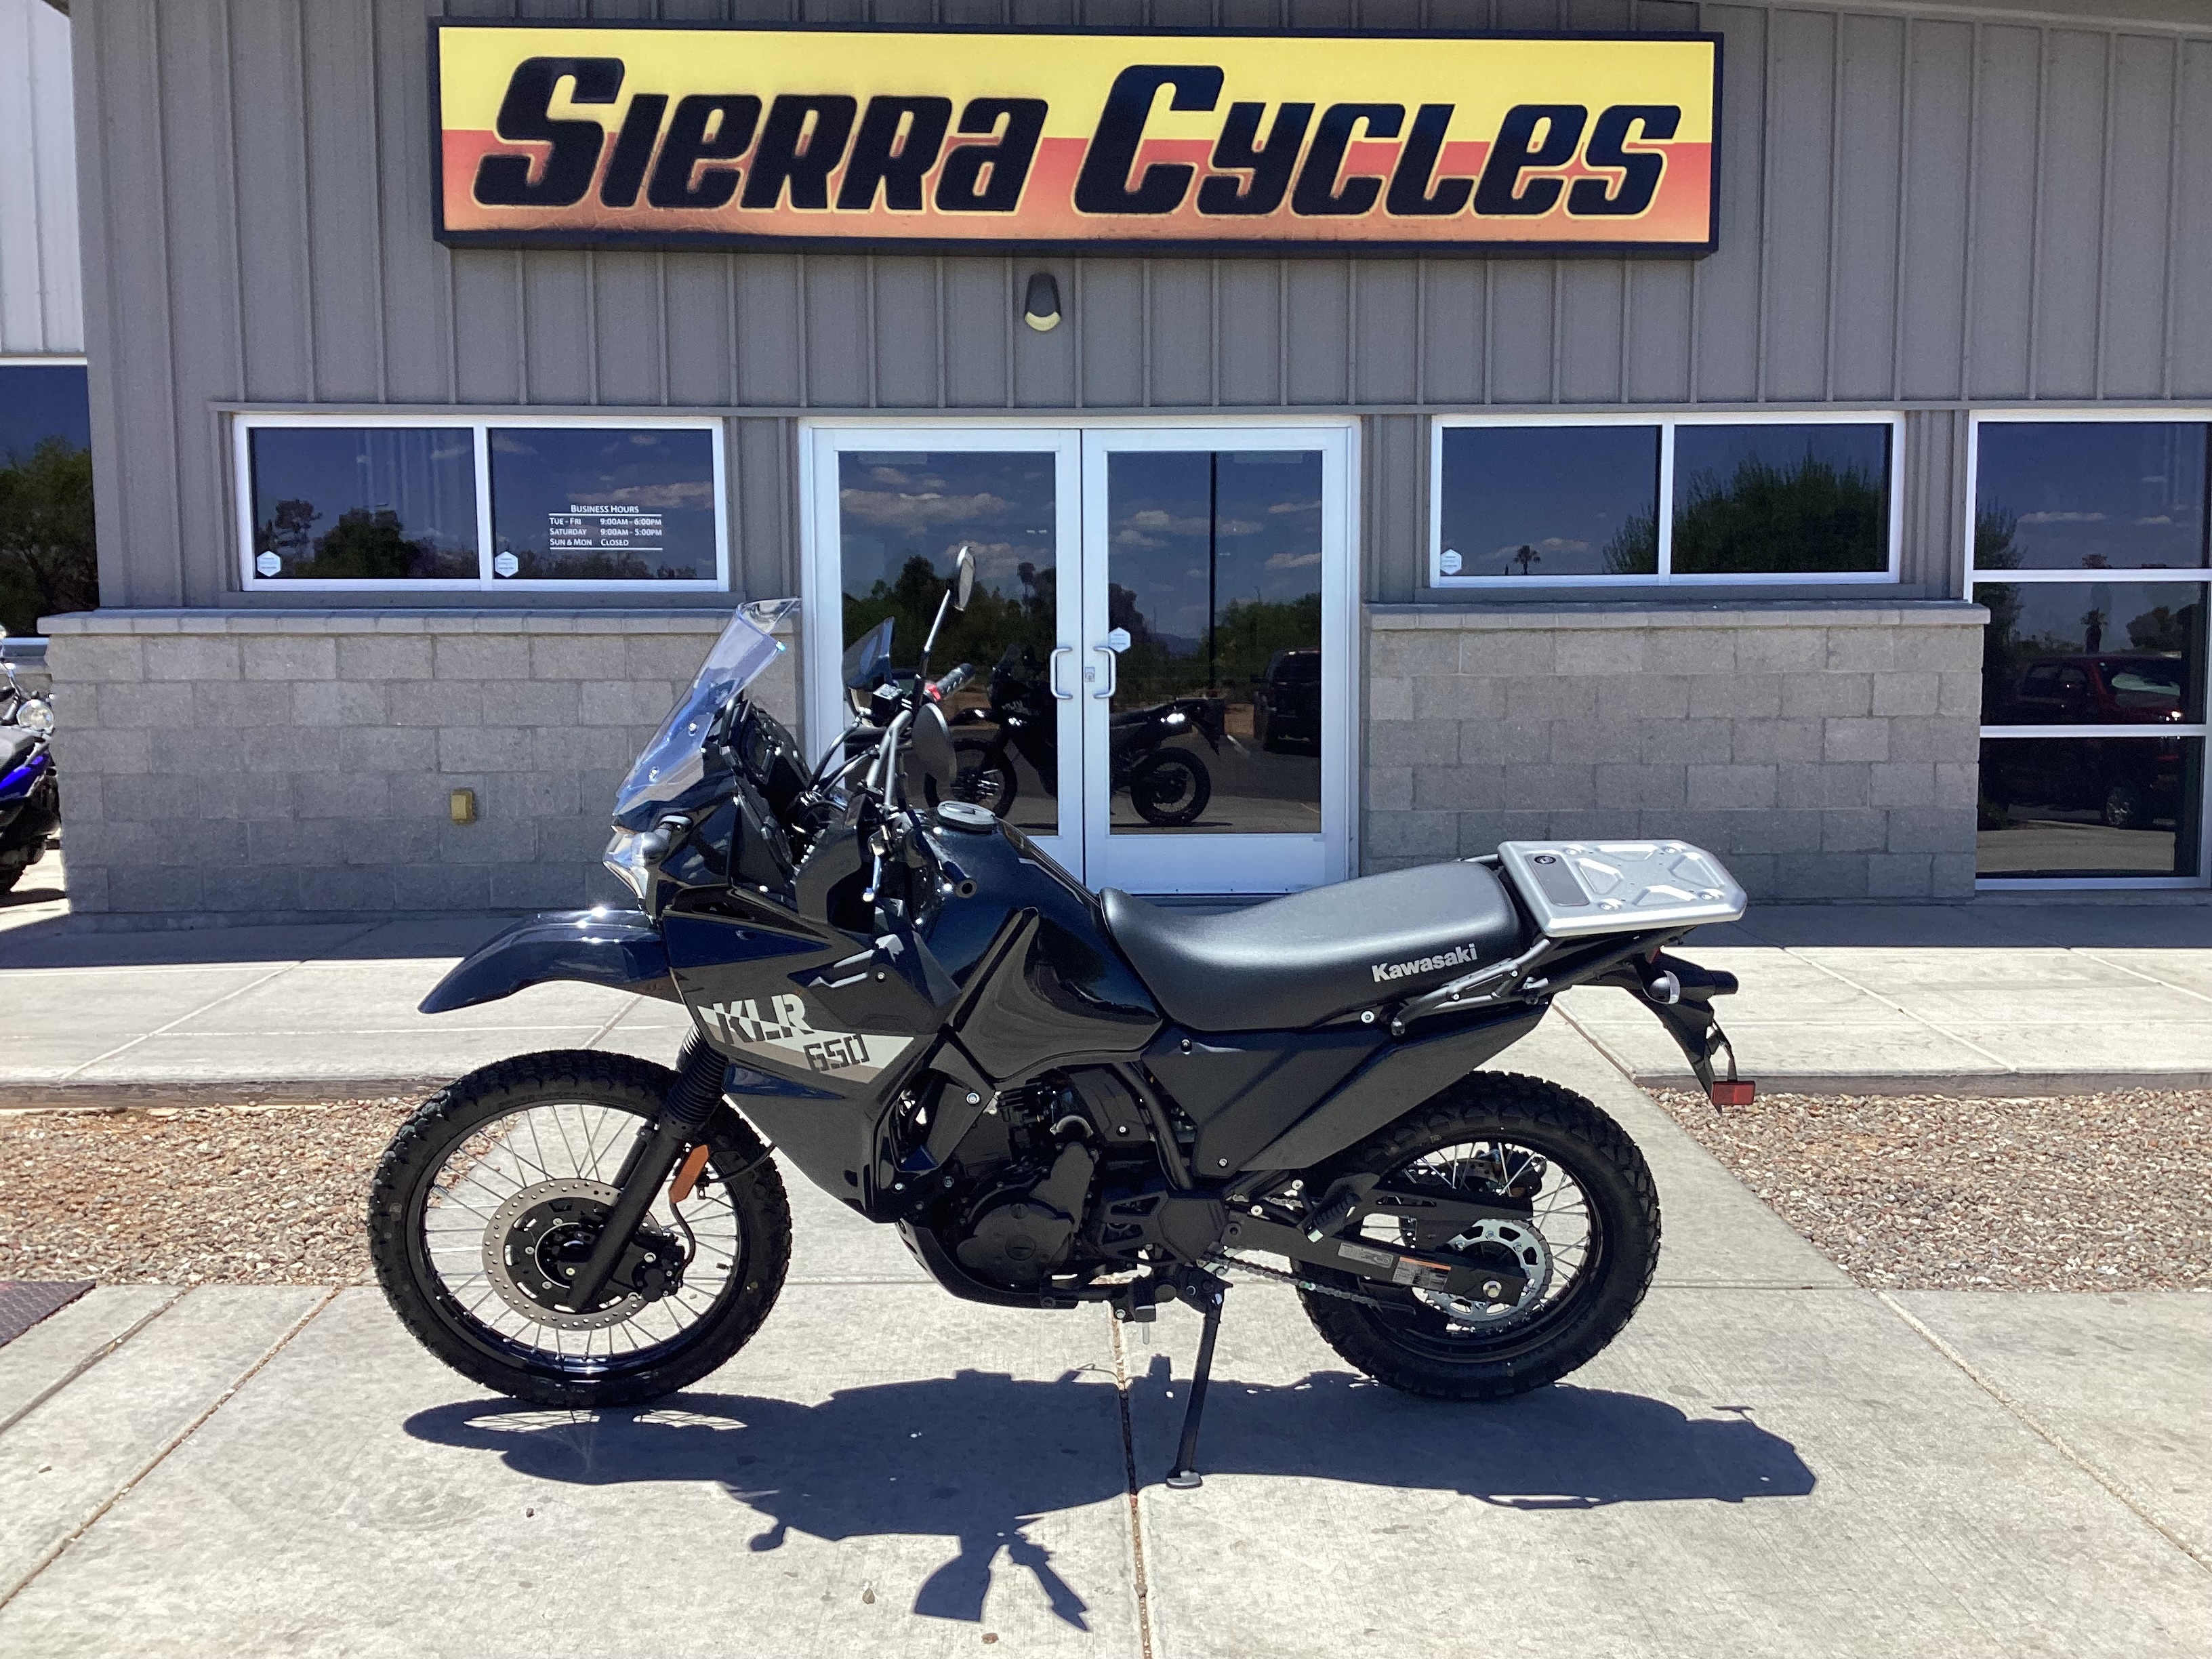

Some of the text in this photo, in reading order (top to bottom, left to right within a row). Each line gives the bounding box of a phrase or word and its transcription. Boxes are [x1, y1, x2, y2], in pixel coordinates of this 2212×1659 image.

[571, 504, 609, 513] BUSINESS
[1372, 943, 1478, 983] Kawasaki
[712, 993, 815, 1045] KLR
[803, 1034, 870, 1073] 650
